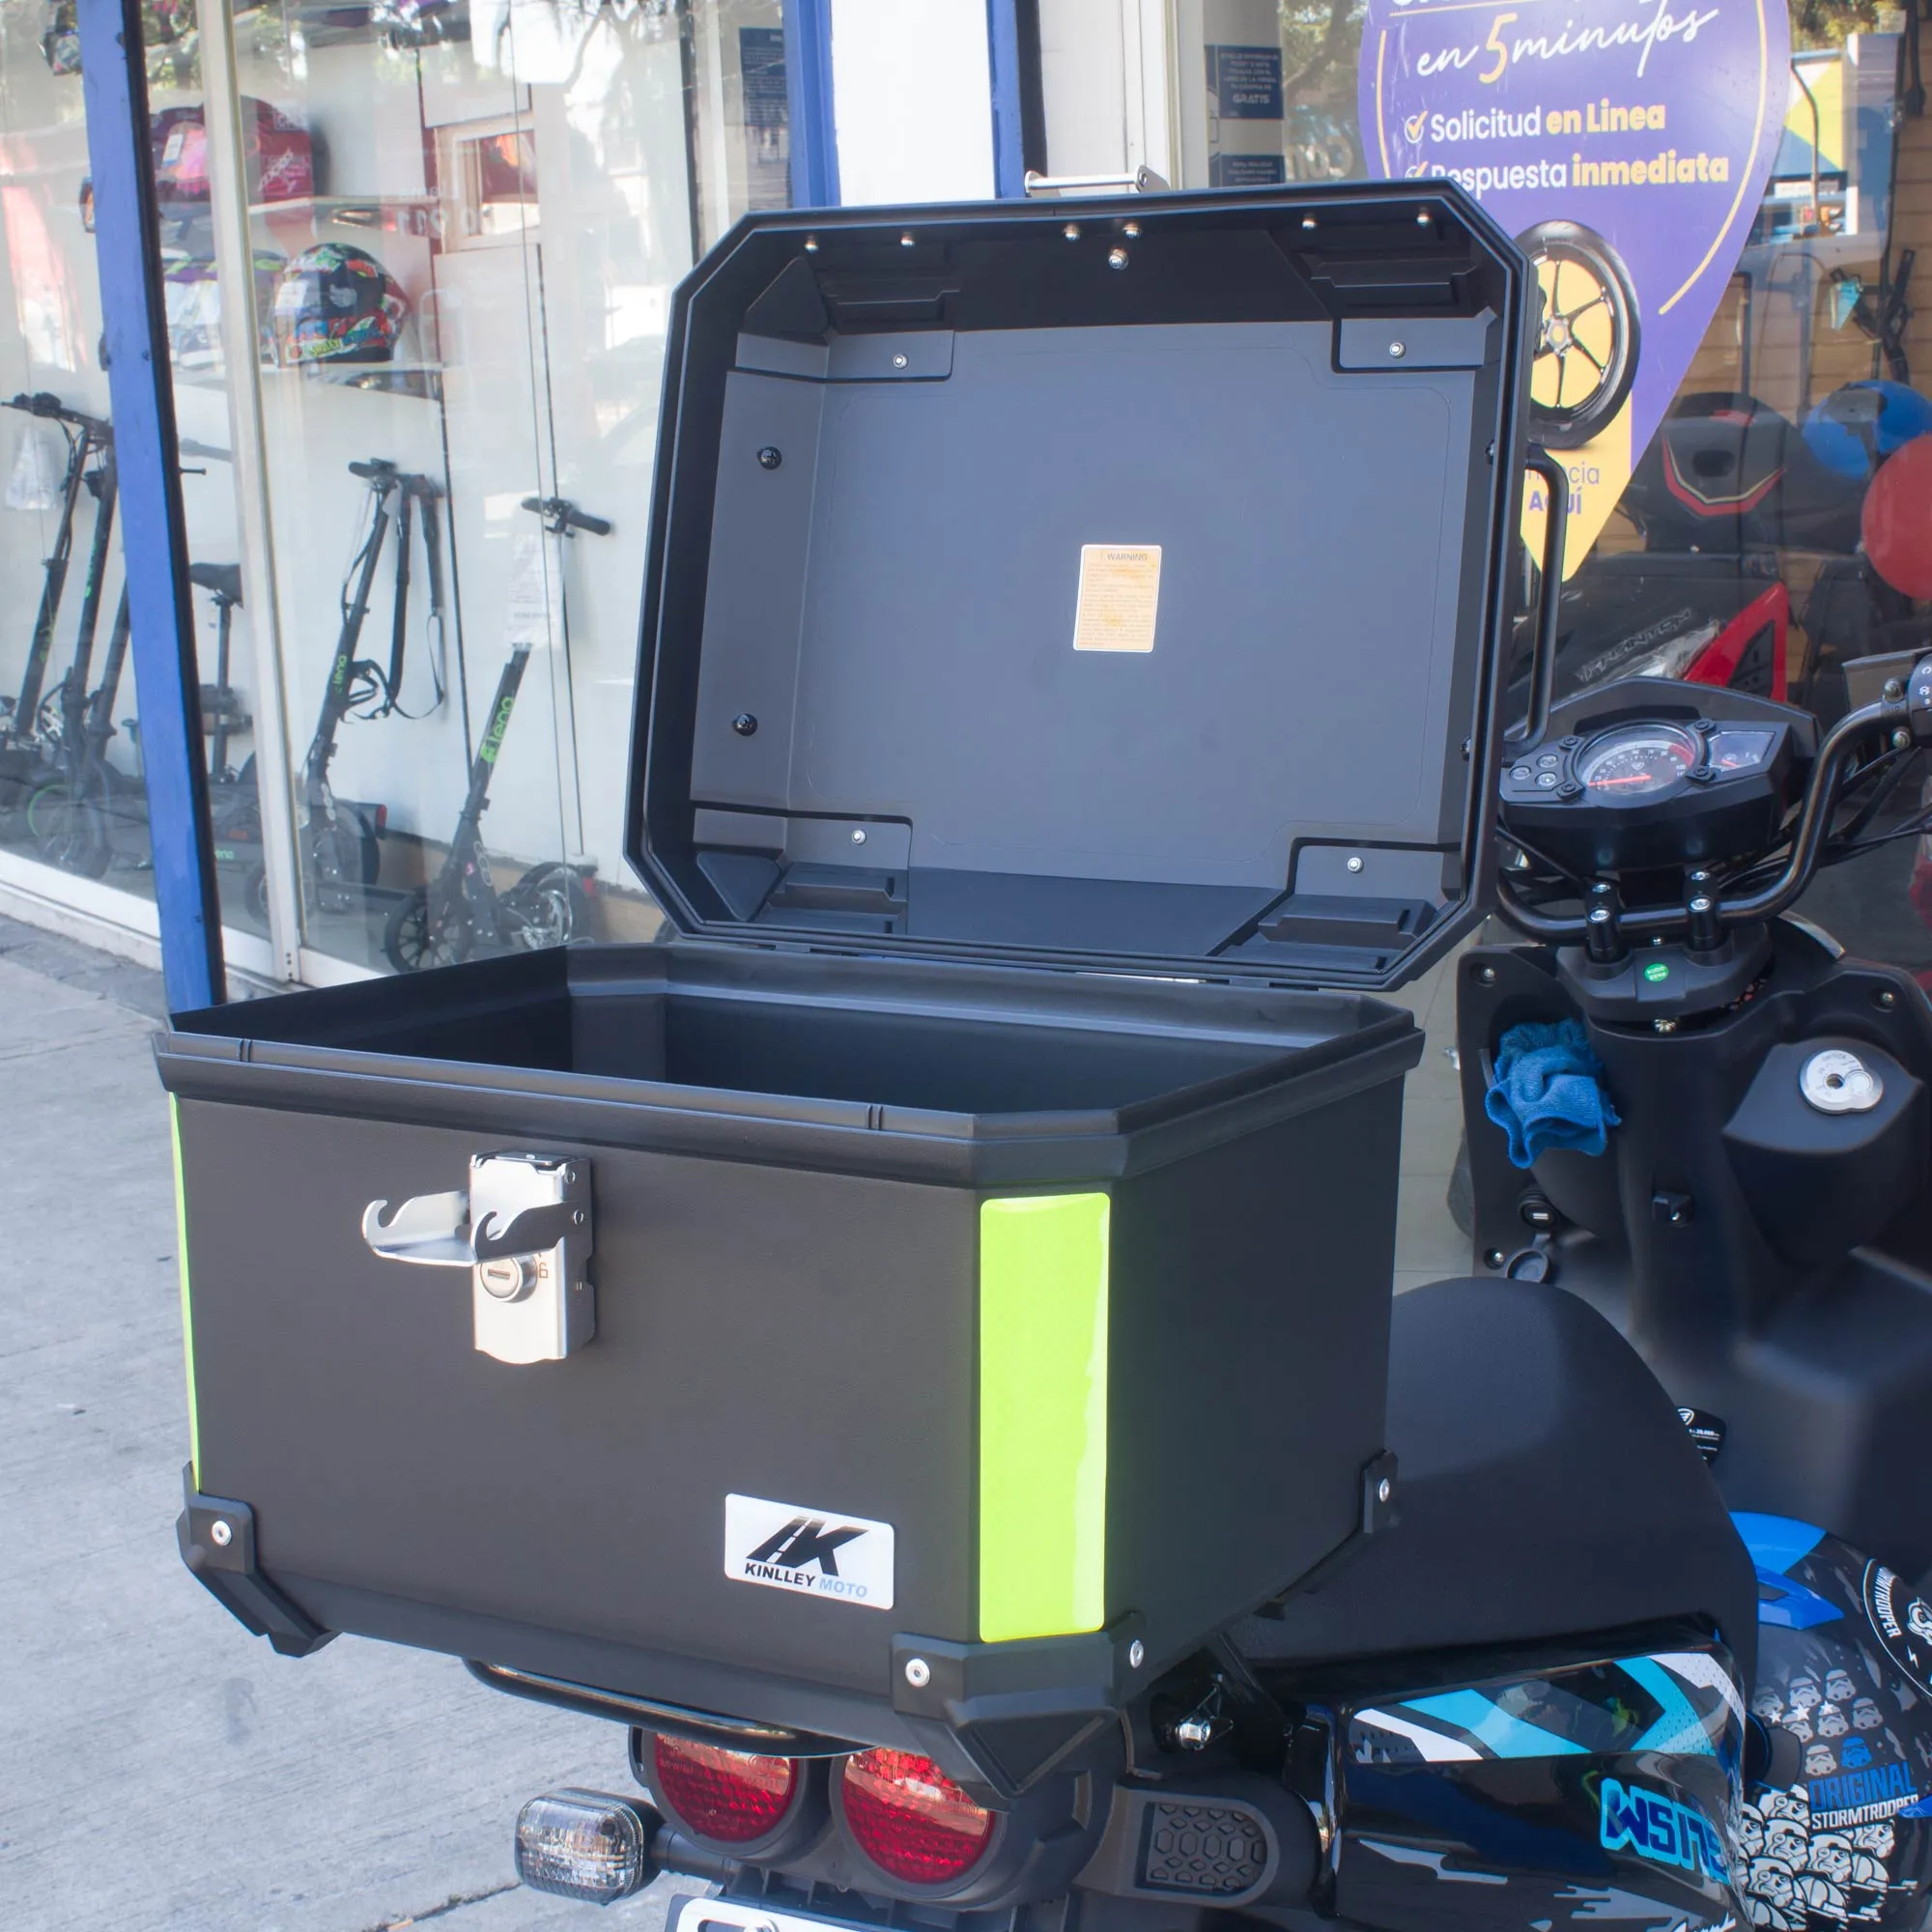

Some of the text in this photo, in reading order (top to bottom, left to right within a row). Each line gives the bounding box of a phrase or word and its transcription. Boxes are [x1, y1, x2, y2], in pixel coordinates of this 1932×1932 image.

[1417, 0, 1719, 84] en 5 minutos
[1431, 99, 1665, 143] Solicitud en Linea
[1572, 149, 1729, 186] inmediata
[1106, 553, 1149, 561] WARNING
[744, 1562, 867, 1599] KINLLEY MOTO
[1808, 1761, 1918, 1811] ORIGINAL
